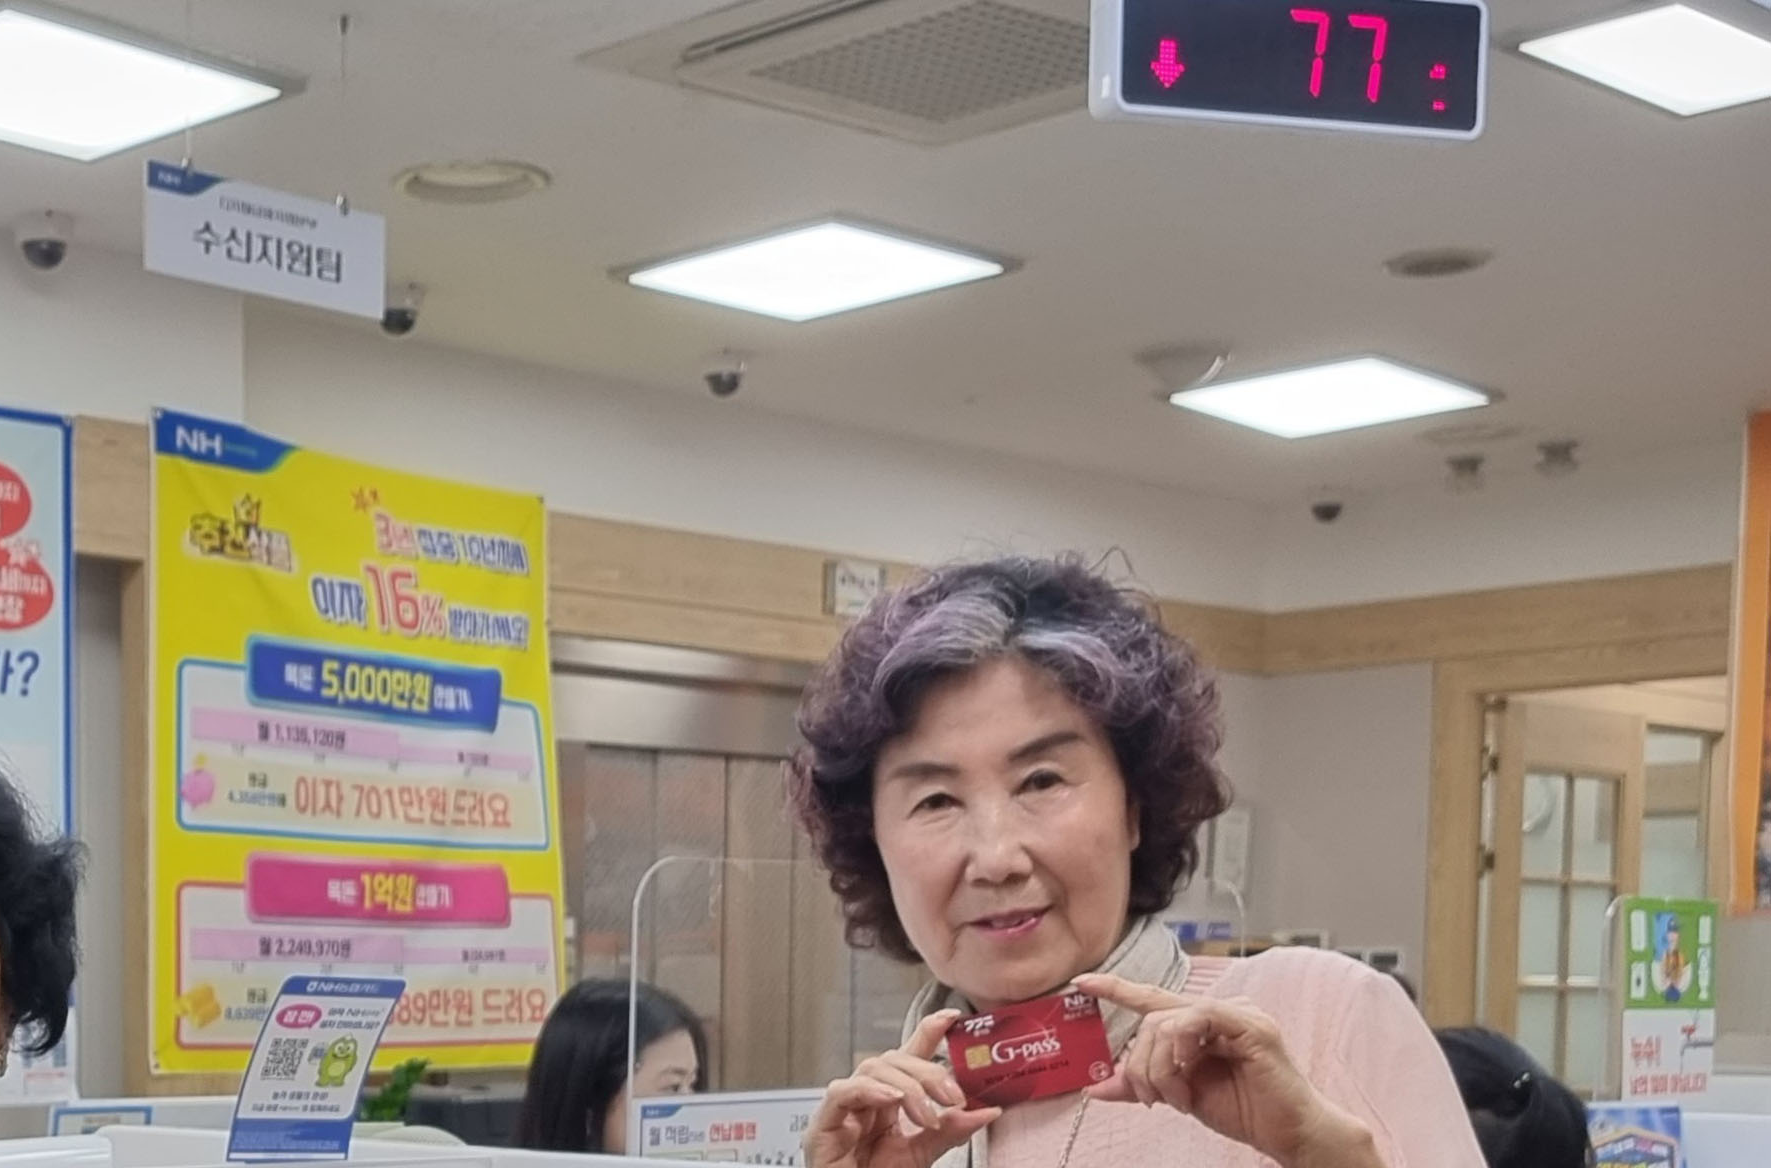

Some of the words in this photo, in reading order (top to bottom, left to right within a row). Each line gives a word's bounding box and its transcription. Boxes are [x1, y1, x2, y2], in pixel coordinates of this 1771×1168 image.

[1291, 9, 1388, 102] 77
[192, 221, 343, 284] 수신지원팀
[176, 425, 223, 457] NH
[363, 562, 448, 639] 16%
[320, 659, 435, 713] 5,000만원
[294, 775, 346, 818] 이자
[992, 1032, 1062, 1064] G-PASS
